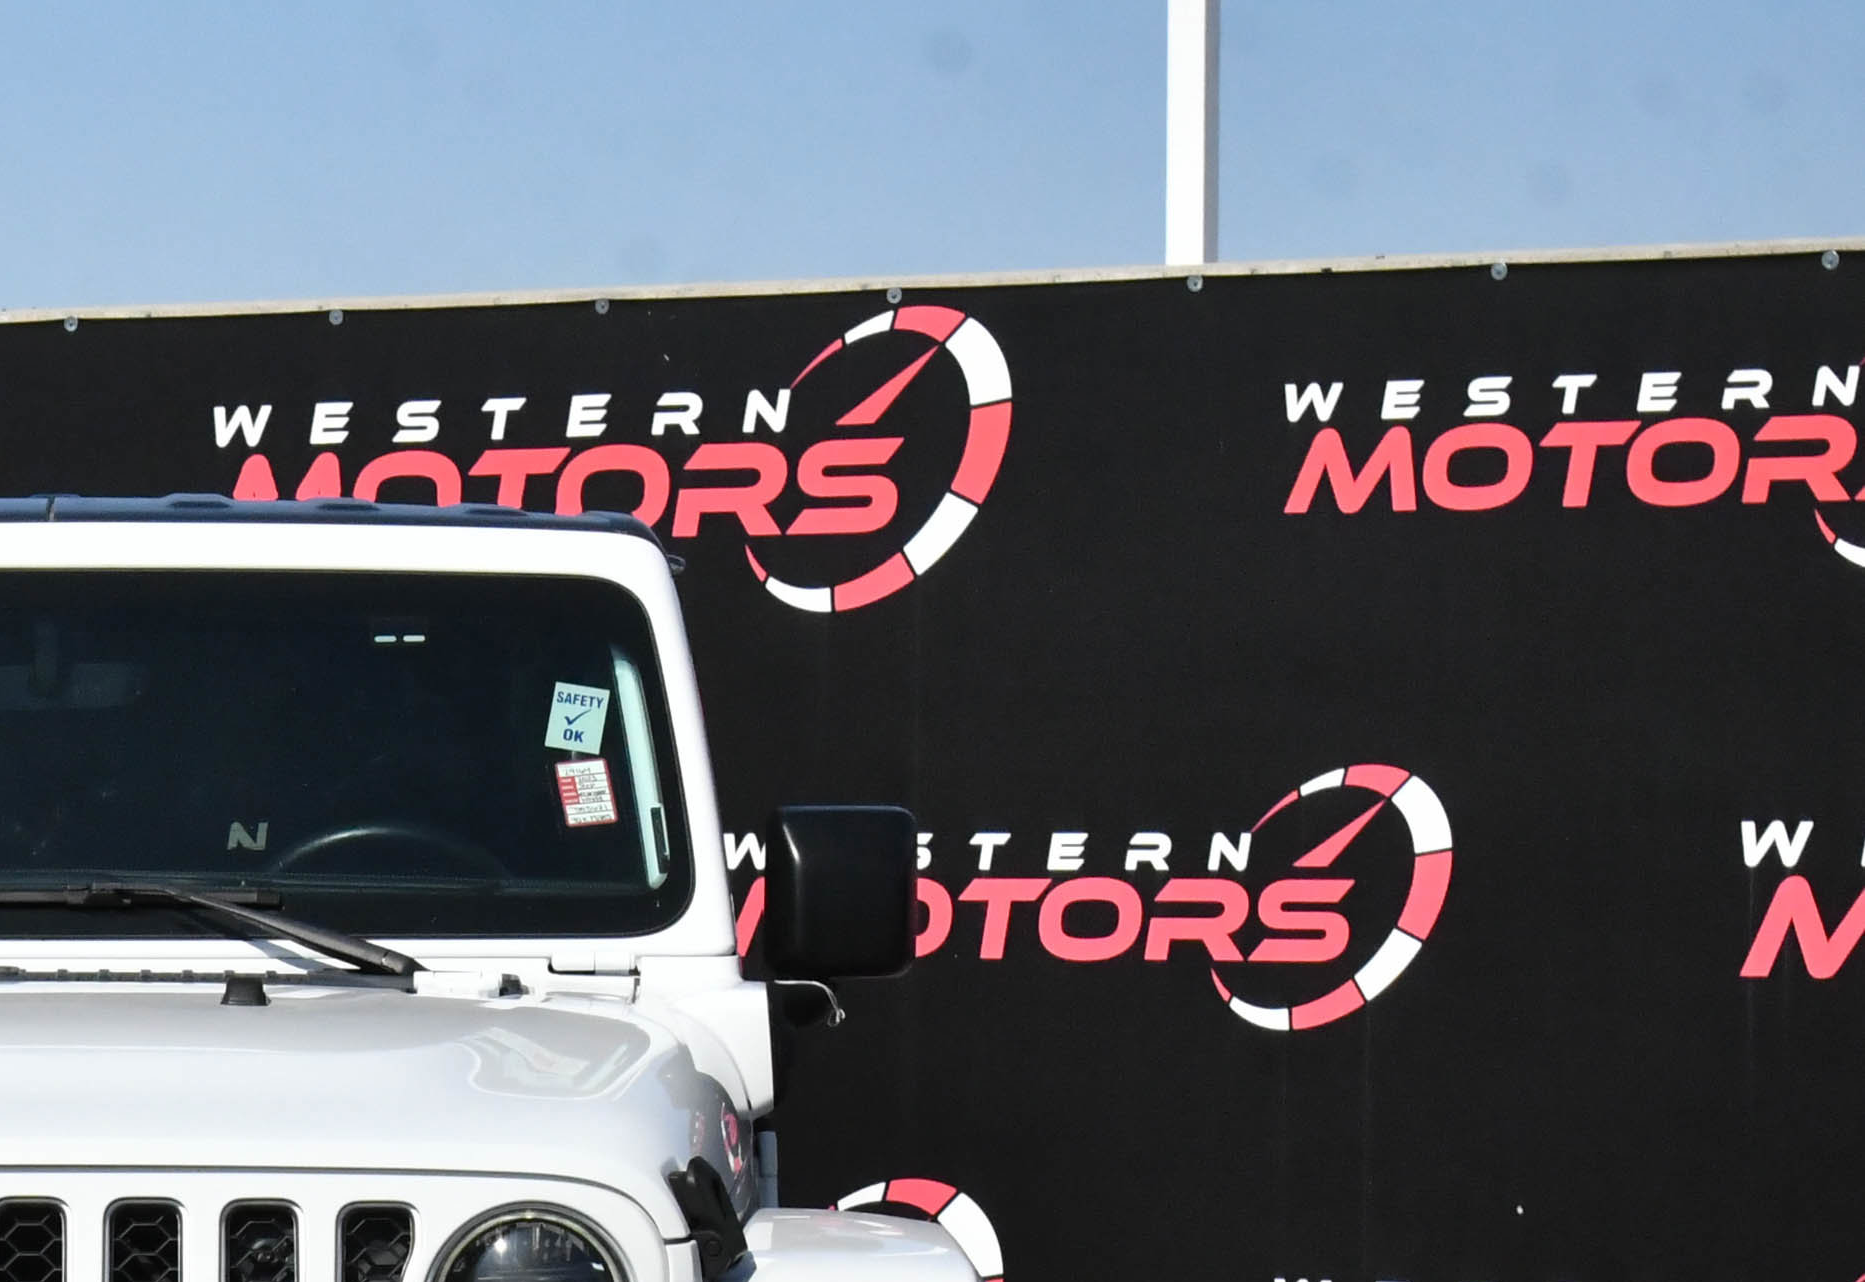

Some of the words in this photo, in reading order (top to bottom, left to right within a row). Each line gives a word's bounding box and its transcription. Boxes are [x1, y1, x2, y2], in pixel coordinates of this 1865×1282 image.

[214, 389, 791, 448] WESTERN
[1285, 365, 1860, 422] WESTERN
[1285, 414, 1865, 514] MOTOR
[556, 691, 604, 709] SAFETY
[563, 728, 584, 743] OK
